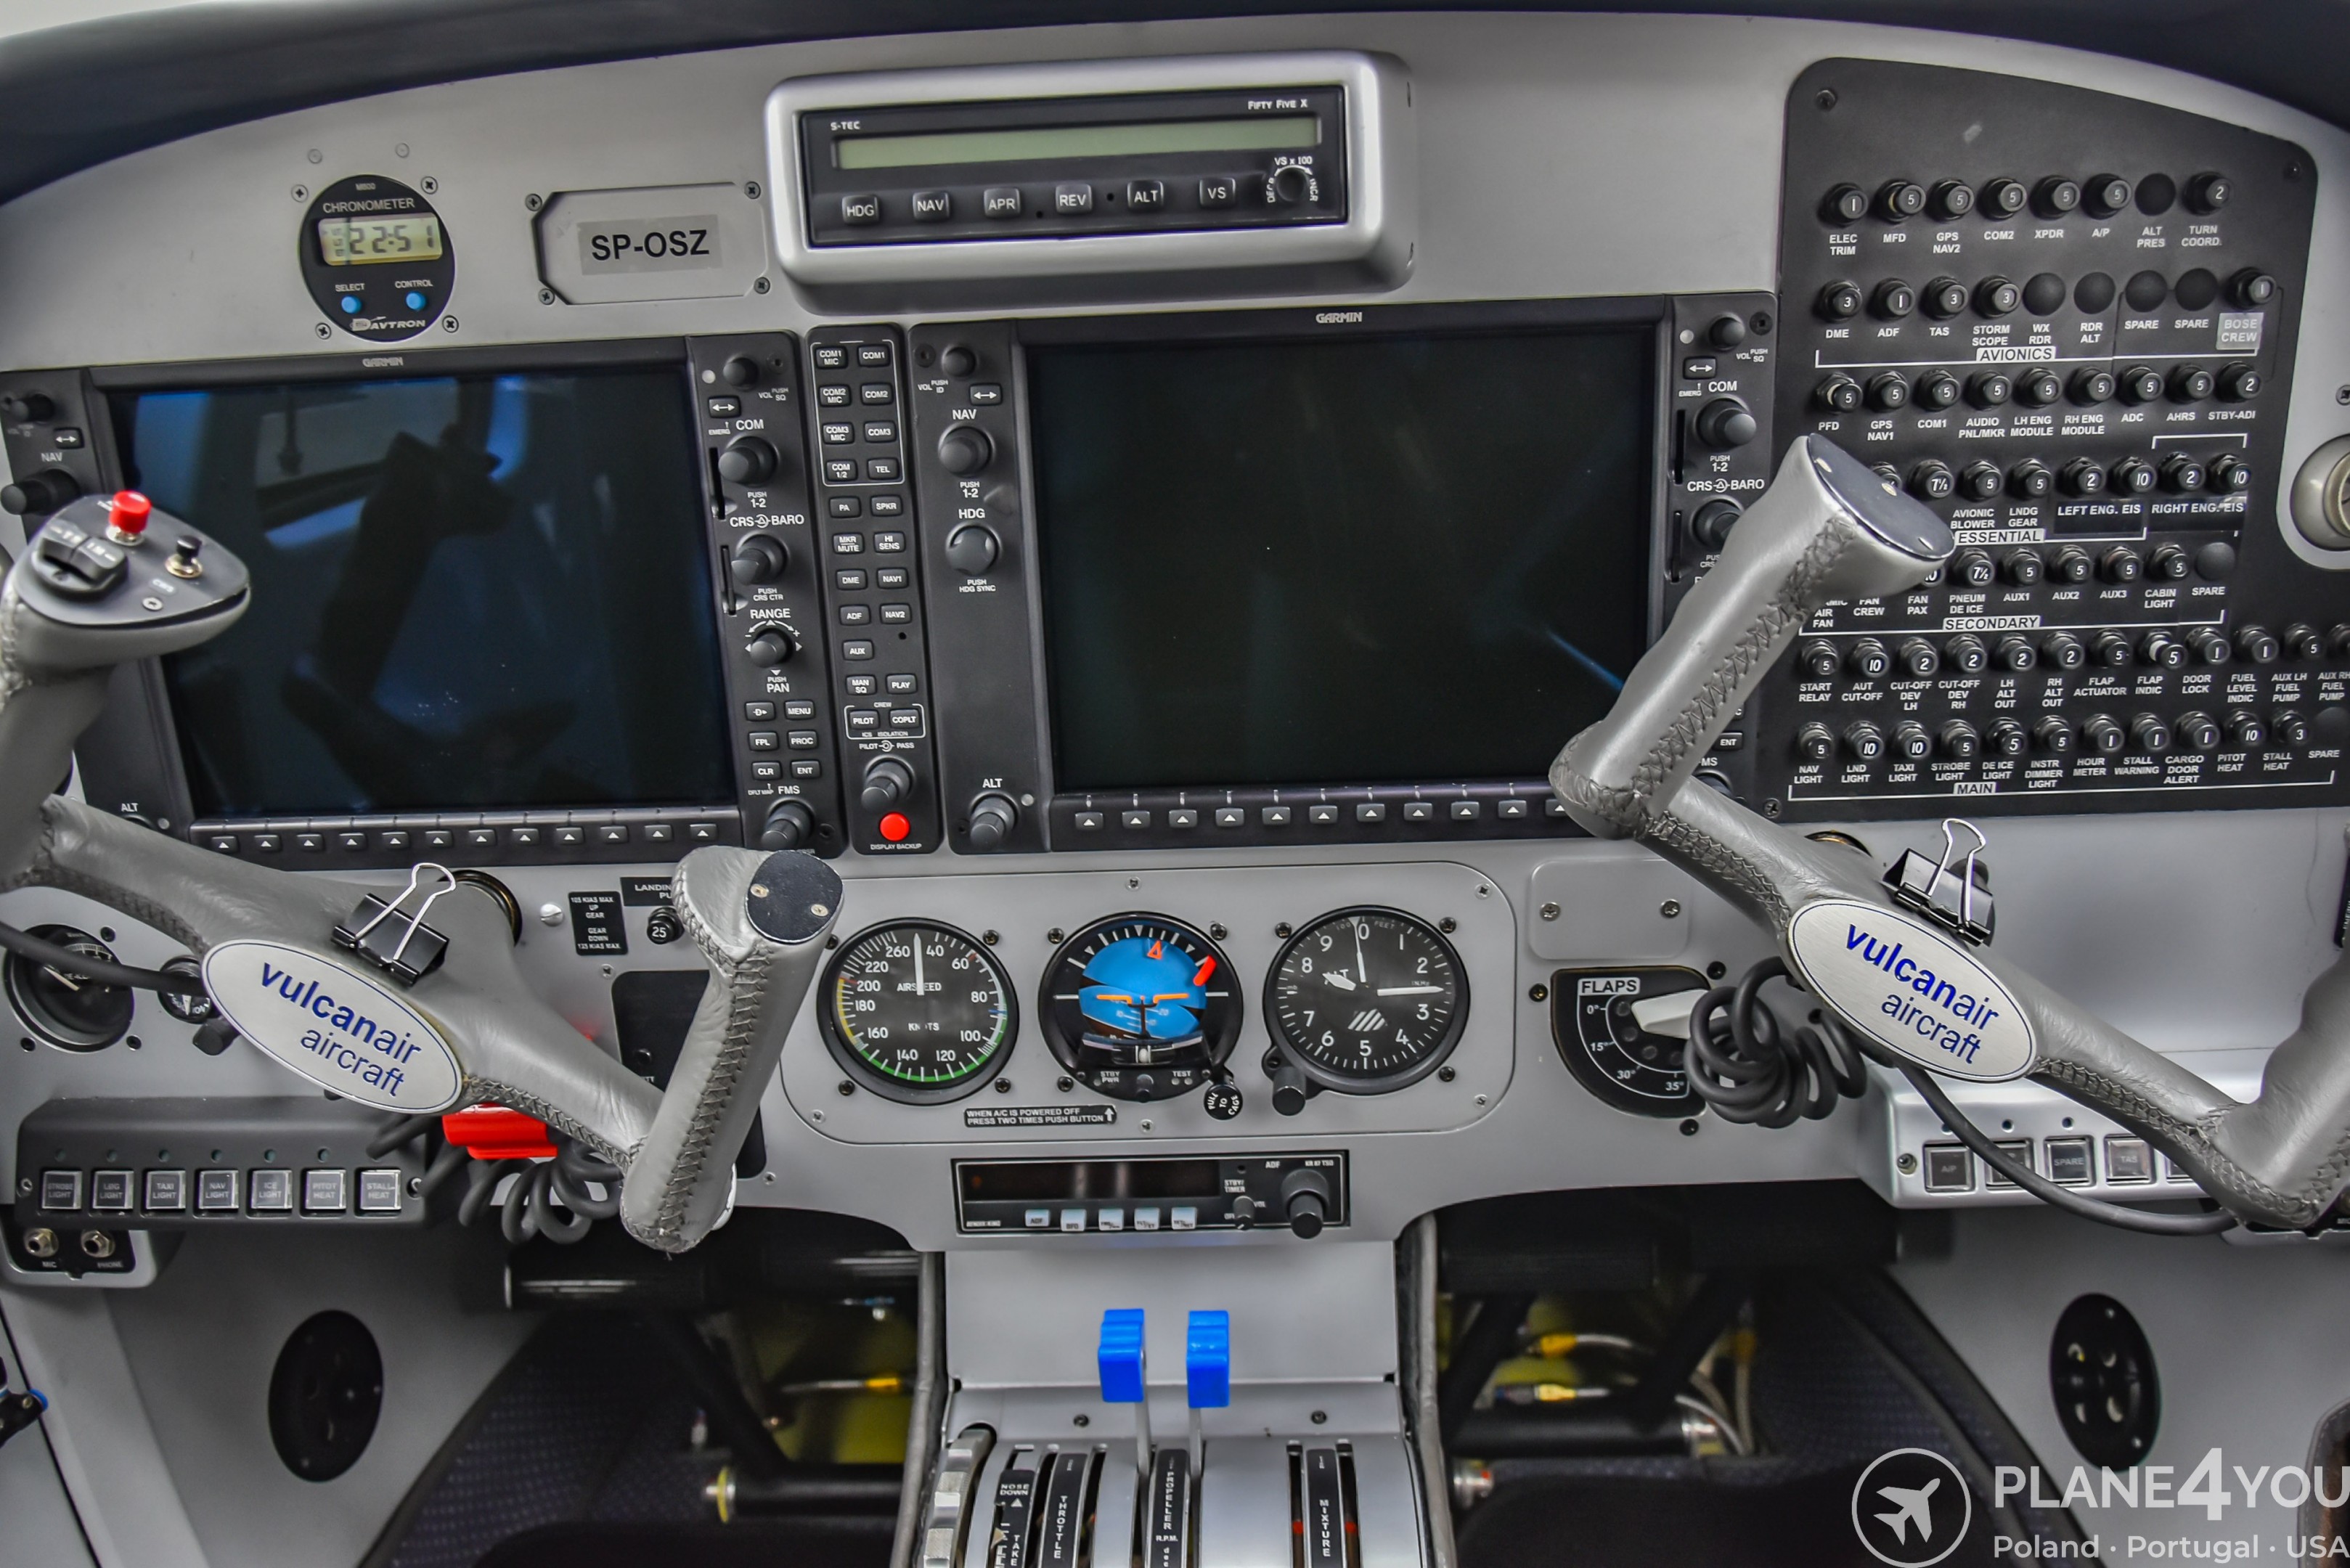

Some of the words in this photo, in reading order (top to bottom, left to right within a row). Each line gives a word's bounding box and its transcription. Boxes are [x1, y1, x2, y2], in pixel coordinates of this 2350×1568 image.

[1248, 101, 1272, 110] FIFTY
[1276, 99, 1297, 108] FIVE
[1300, 99, 1307, 107] X
[831, 121, 860, 131] S-TEC
[1134, 189, 1159, 204] ALT
[1207, 187, 1227, 200] VS
[323, 197, 415, 213] CHRONOMETER
[988, 197, 1015, 211] APR
[1059, 193, 1086, 207] REV
[917, 199, 944, 212] NAV
[846, 204, 874, 218] HDG
[2035, 229, 2064, 239] XPDR
[2092, 229, 2110, 237] A/P
[2142, 226, 2162, 235] ALT
[2190, 226, 2217, 234] TURN
[1829, 234, 1857, 243] ELEC
[1883, 234, 1906, 242] MFD
[1937, 232, 1959, 241] GPS
[1984, 232, 2014, 240] COM2
[592, 230, 709, 260] SP-OSZ
[2137, 239, 2165, 248] PRES
[2182, 237, 2222, 247] COORD.
[1831, 246, 1856, 255] TRIM
[1933, 244, 1960, 253] NAV2
[395, 279, 433, 288] CONTROL
[1315, 312, 1362, 323] GARMIN
[2033, 324, 2049, 332] WX
[2080, 322, 2102, 331] RDR
[2125, 320, 2158, 329] SPARE
[2174, 319, 2209, 328] SPARE
[2224, 319, 2257, 329] BOSE
[1826, 330, 1849, 338] DME
[1877, 328, 1899, 337] ADF
[1930, 327, 1949, 336] TAS
[1973, 325, 2010, 335] STORM
[1972, 337, 2008, 346] SCOPE
[2222, 332, 2256, 343] CREW
[1980, 348, 2052, 361] AVIONICS
[1708, 381, 1737, 392] COM
[952, 409, 976, 420] NAV
[2121, 413, 2144, 422] ADC
[2166, 412, 2195, 421] AHRS
[2208, 411, 2255, 420] STBY-ADI
[735, 419, 764, 430] COM
[1871, 420, 1893, 429] GPS
[1918, 420, 1947, 428] COM1
[1966, 417, 1999, 427] AUDIO
[2014, 416, 2028, 425] LH
[2030, 416, 2052, 425] ENG
[1819, 422, 1839, 430] PFD
[1867, 432, 1894, 441] NAV1
[1959, 429, 2004, 438] PNL/MKR
[2010, 428, 2053, 436] MODULE
[1687, 481, 1713, 491] CRS
[1731, 479, 1764, 489] BARO
[958, 509, 985, 518] HDG
[1953, 508, 1994, 518] AVIONIC
[2010, 507, 2038, 516] LNDG
[2057, 506, 2087, 515] LEFT
[2090, 505, 2118, 515] ENG.
[2122, 505, 2141, 513] EIS
[730, 517, 754, 527] CRS
[771, 515, 804, 525] BARO
[1951, 520, 1995, 528] BLOWER
[2008, 518, 2038, 527] GEAR
[1959, 531, 2041, 543] ESSENTIAL
[2100, 590, 2127, 599] AUX3
[2145, 589, 2176, 597] CABIN
[1949, 594, 1986, 603] PNEUM
[2145, 600, 2174, 608] LIGHT
[750, 608, 791, 618] RANGE
[1945, 617, 2039, 630] SECONDARY
[2089, 677, 2114, 686] FLAP
[2183, 674, 2211, 683] DOOR
[767, 683, 790, 693] PAN
[2073, 687, 2127, 696] ACTUATOR
[2123, 756, 2153, 765] STALL
[1799, 765, 1819, 774] NAV
[2115, 767, 2159, 775] WARNING
[982, 779, 1003, 788] ALT
[1794, 775, 1822, 784] LIGHT
[778, 785, 800, 794] FMS
[1957, 783, 1994, 794] MAIN
[652, 927, 666, 937] 25
[1358, 923, 1369, 939] 0
[1320, 936, 1332, 952] 9
[886, 946, 910, 957] 260
[926, 945, 944, 957] 40
[865, 961, 889, 973] 220
[952, 958, 969, 970] 60
[1302, 957, 1313, 973] 8
[1417, 957, 1427, 973] 2
[1846, 923, 1999, 1030] vulcanair
[857, 980, 881, 992] 200
[1582, 980, 1637, 994] FLAPS
[971, 992, 987, 1003] 80
[855, 1000, 876, 1011] 180
[261, 963, 421, 1063] vulcanair
[1417, 1004, 1429, 1020] 3
[1303, 1010, 1314, 1026] 7
[868, 1027, 889, 1038] 160
[1881, 993, 1980, 1064] aircraft
[960, 1030, 981, 1042] 100
[1321, 1030, 1334, 1047] 6
[1395, 1029, 1408, 1045] 4
[1360, 1040, 1371, 1055] 5
[897, 1050, 918, 1060] 140
[937, 1050, 955, 1061] 120
[301, 1029, 404, 1097] aircraft
[1053, 1496, 1067, 1559] THROTTLE
[1319, 1499, 1331, 1556] MIXTURE
